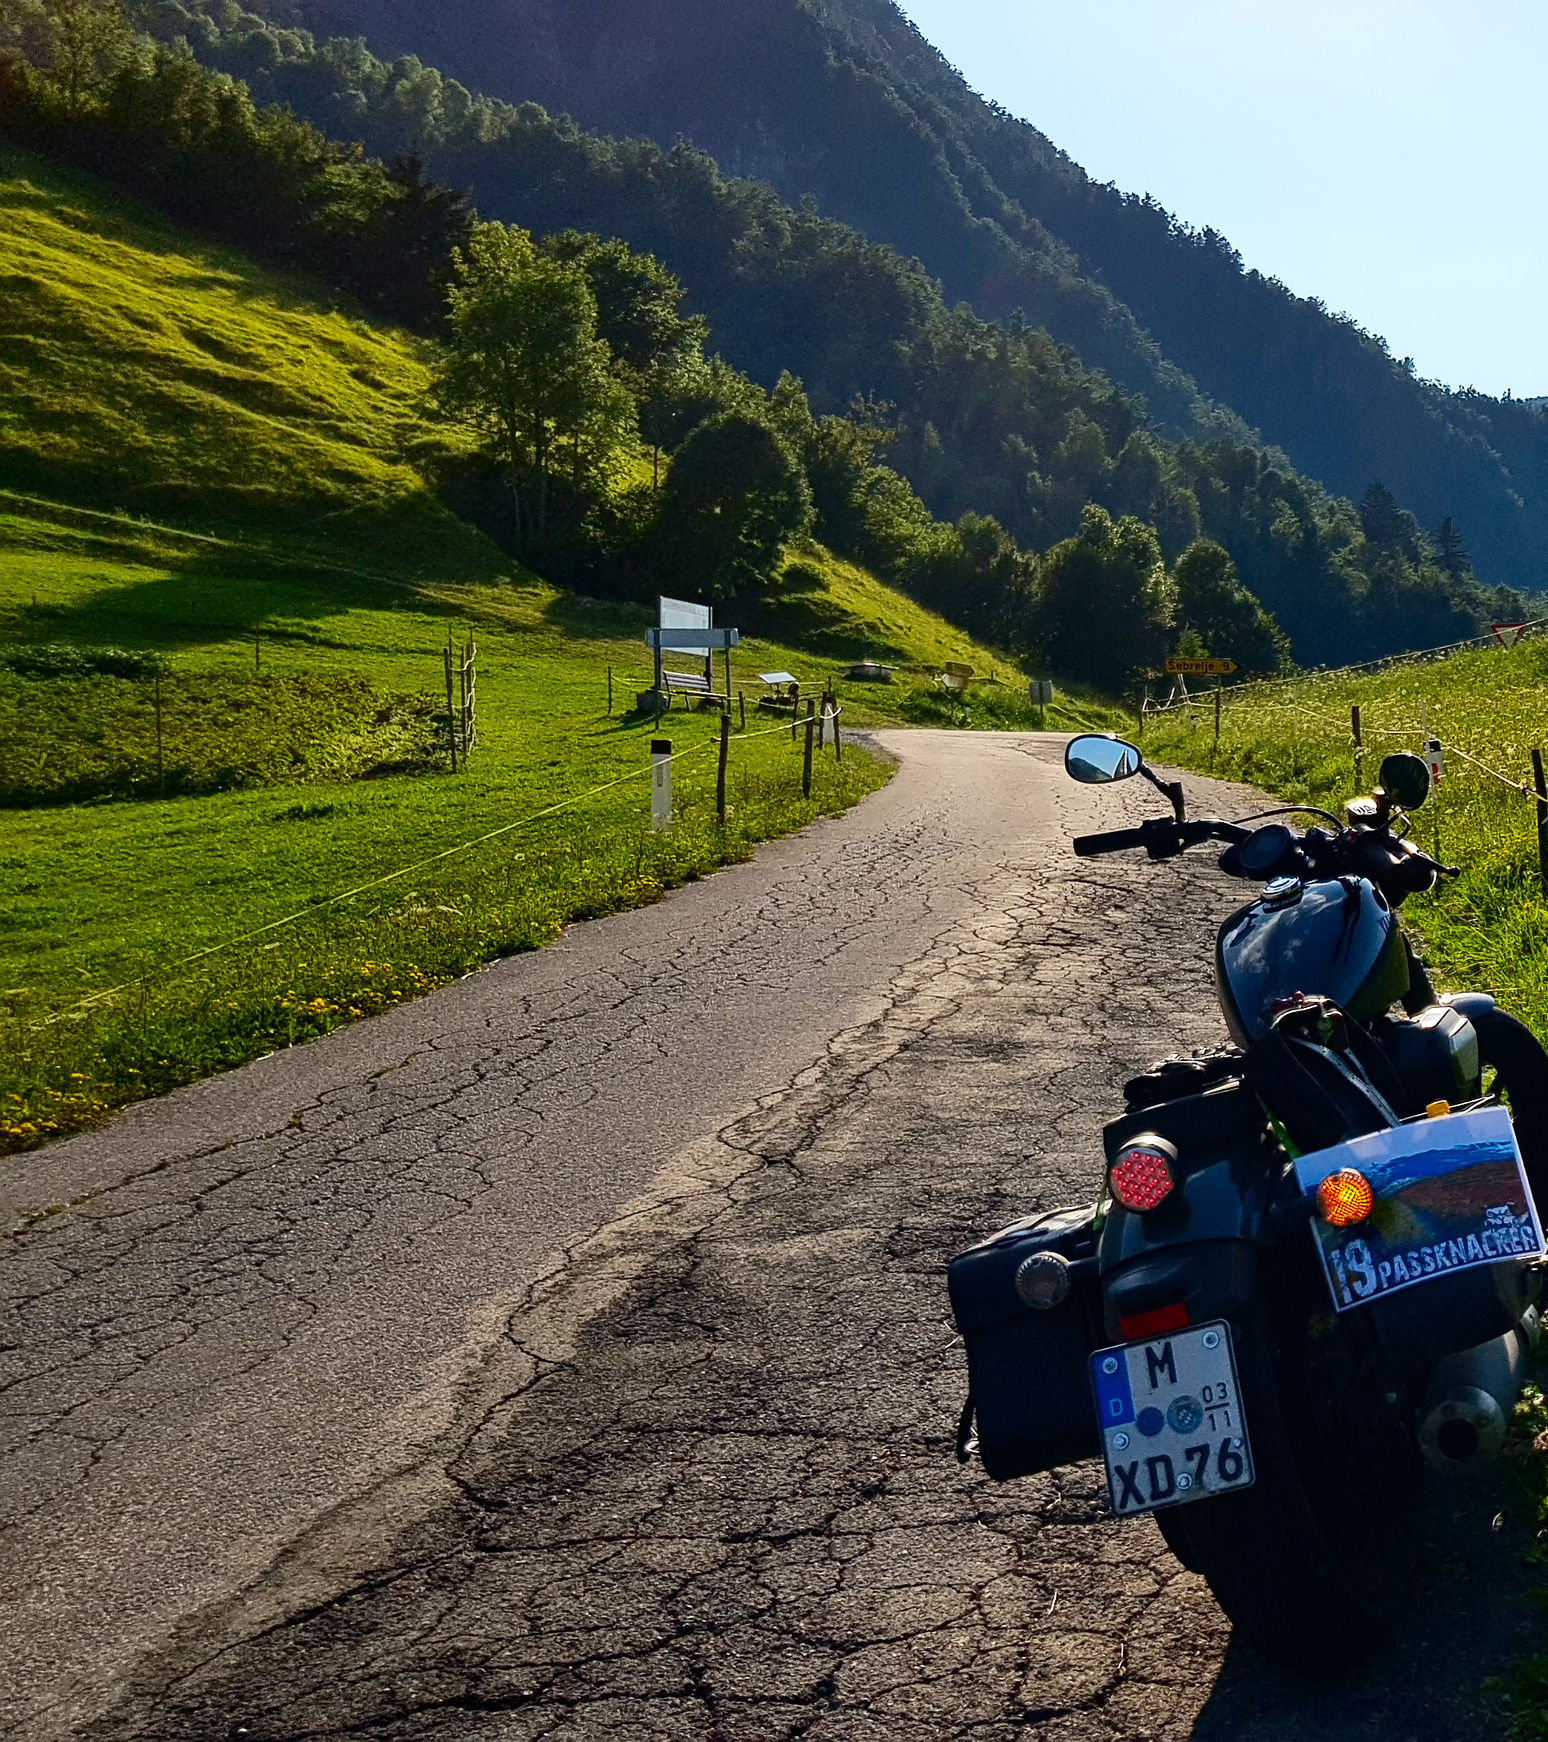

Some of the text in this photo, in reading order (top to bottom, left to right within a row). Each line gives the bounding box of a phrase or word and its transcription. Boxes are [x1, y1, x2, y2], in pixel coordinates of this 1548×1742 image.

[1222, 661, 1230, 671] 9
[1378, 1225, 1538, 1288] PASSKNACKER
[1145, 1341, 1177, 1388] M
[1202, 1381, 1228, 1403] 03
[1109, 1397, 1123, 1417] D
[1208, 1410, 1231, 1431] 11
